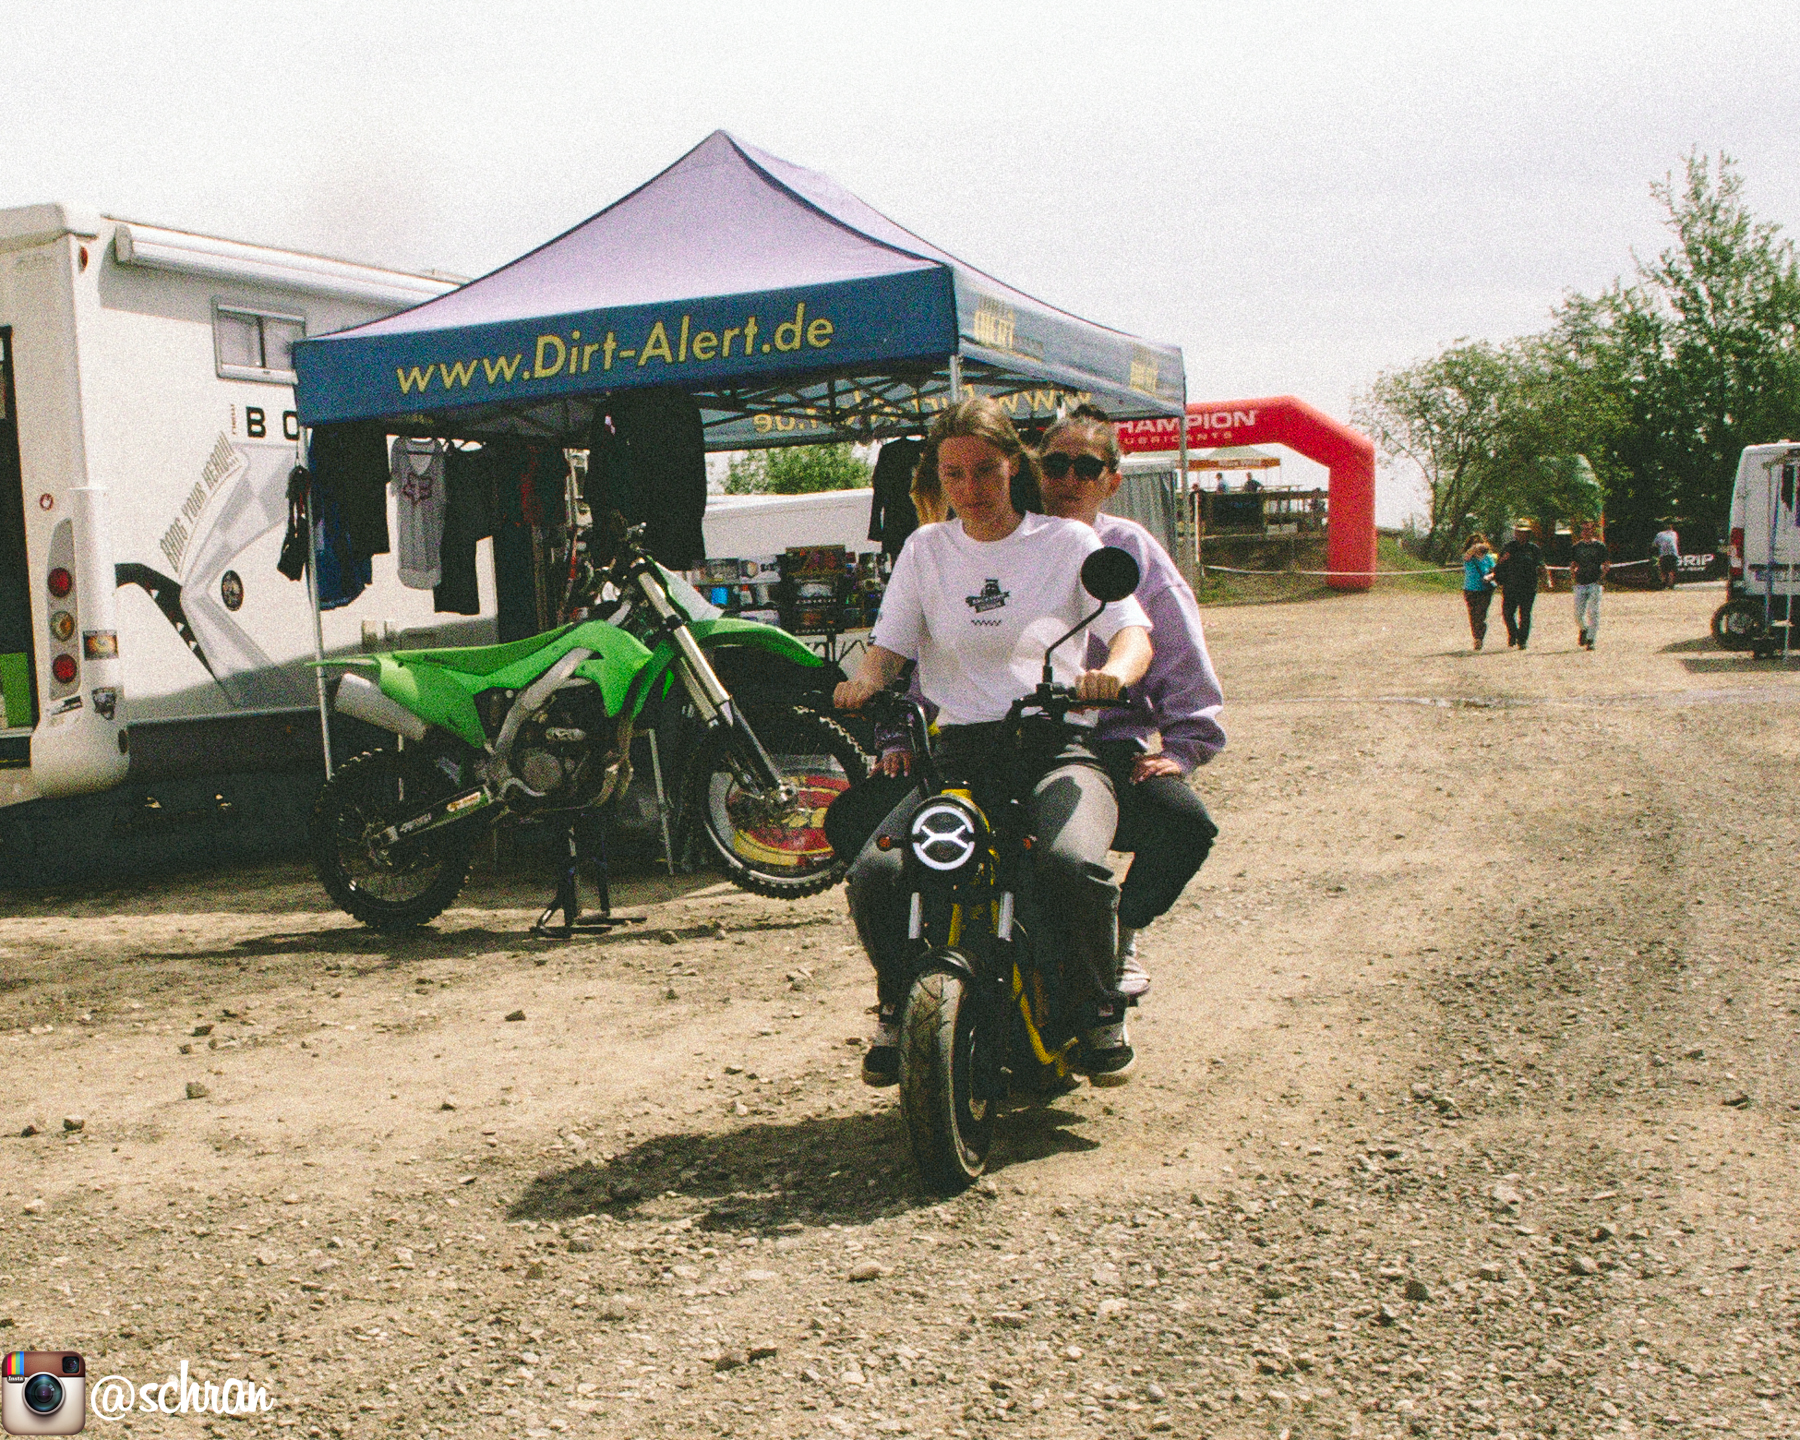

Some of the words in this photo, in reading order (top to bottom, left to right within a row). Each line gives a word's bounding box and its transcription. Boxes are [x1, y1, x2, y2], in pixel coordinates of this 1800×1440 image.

[396, 303, 834, 394] www.Dirt-Alert.de
[1115, 410, 1258, 433] HAMPION
[1123, 431, 1234, 445] UBRICANTS
[181, 482, 207, 524] YOUR
